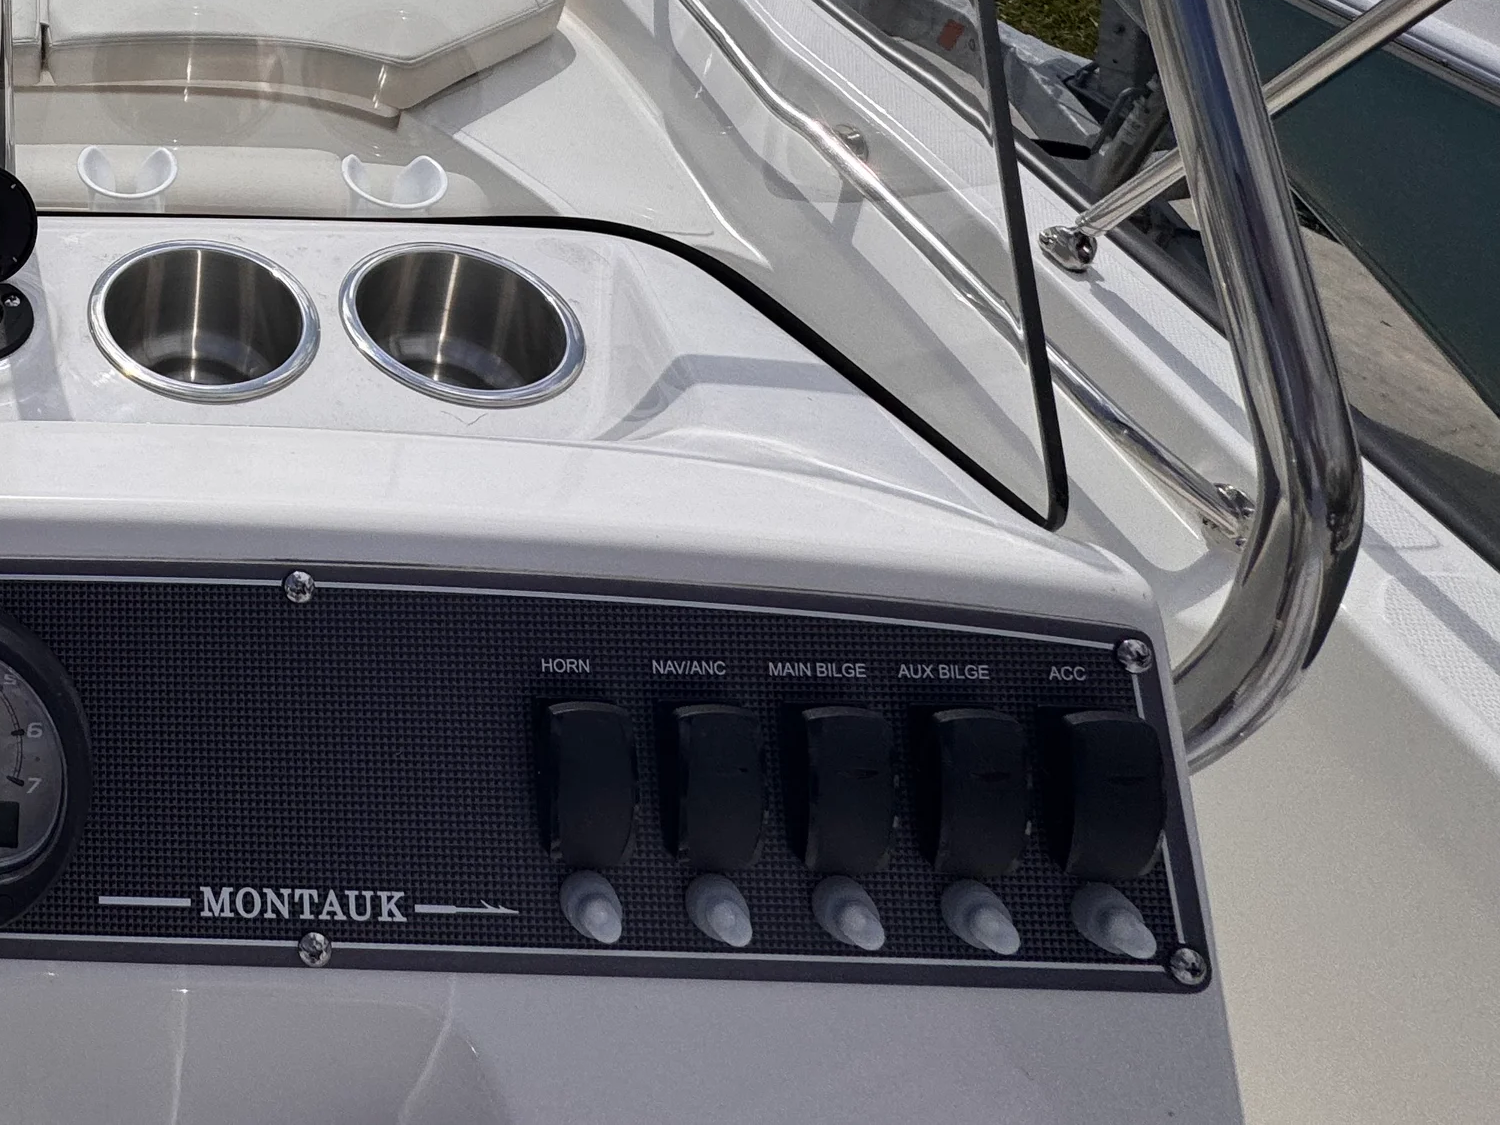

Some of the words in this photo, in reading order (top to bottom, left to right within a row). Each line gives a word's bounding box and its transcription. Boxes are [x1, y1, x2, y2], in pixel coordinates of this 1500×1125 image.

[541, 658, 590, 673] HORN
[652, 660, 726, 675] NAV/ANC
[768, 662, 811, 677] MAIN
[816, 663, 867, 678] BILGE
[898, 663, 933, 678] AUX
[938, 665, 989, 680] BILGE
[1049, 666, 1087, 681] ACC
[26, 722, 43, 738] 6
[26, 777, 42, 794] 7
[200, 886, 407, 923] MONTAUK
